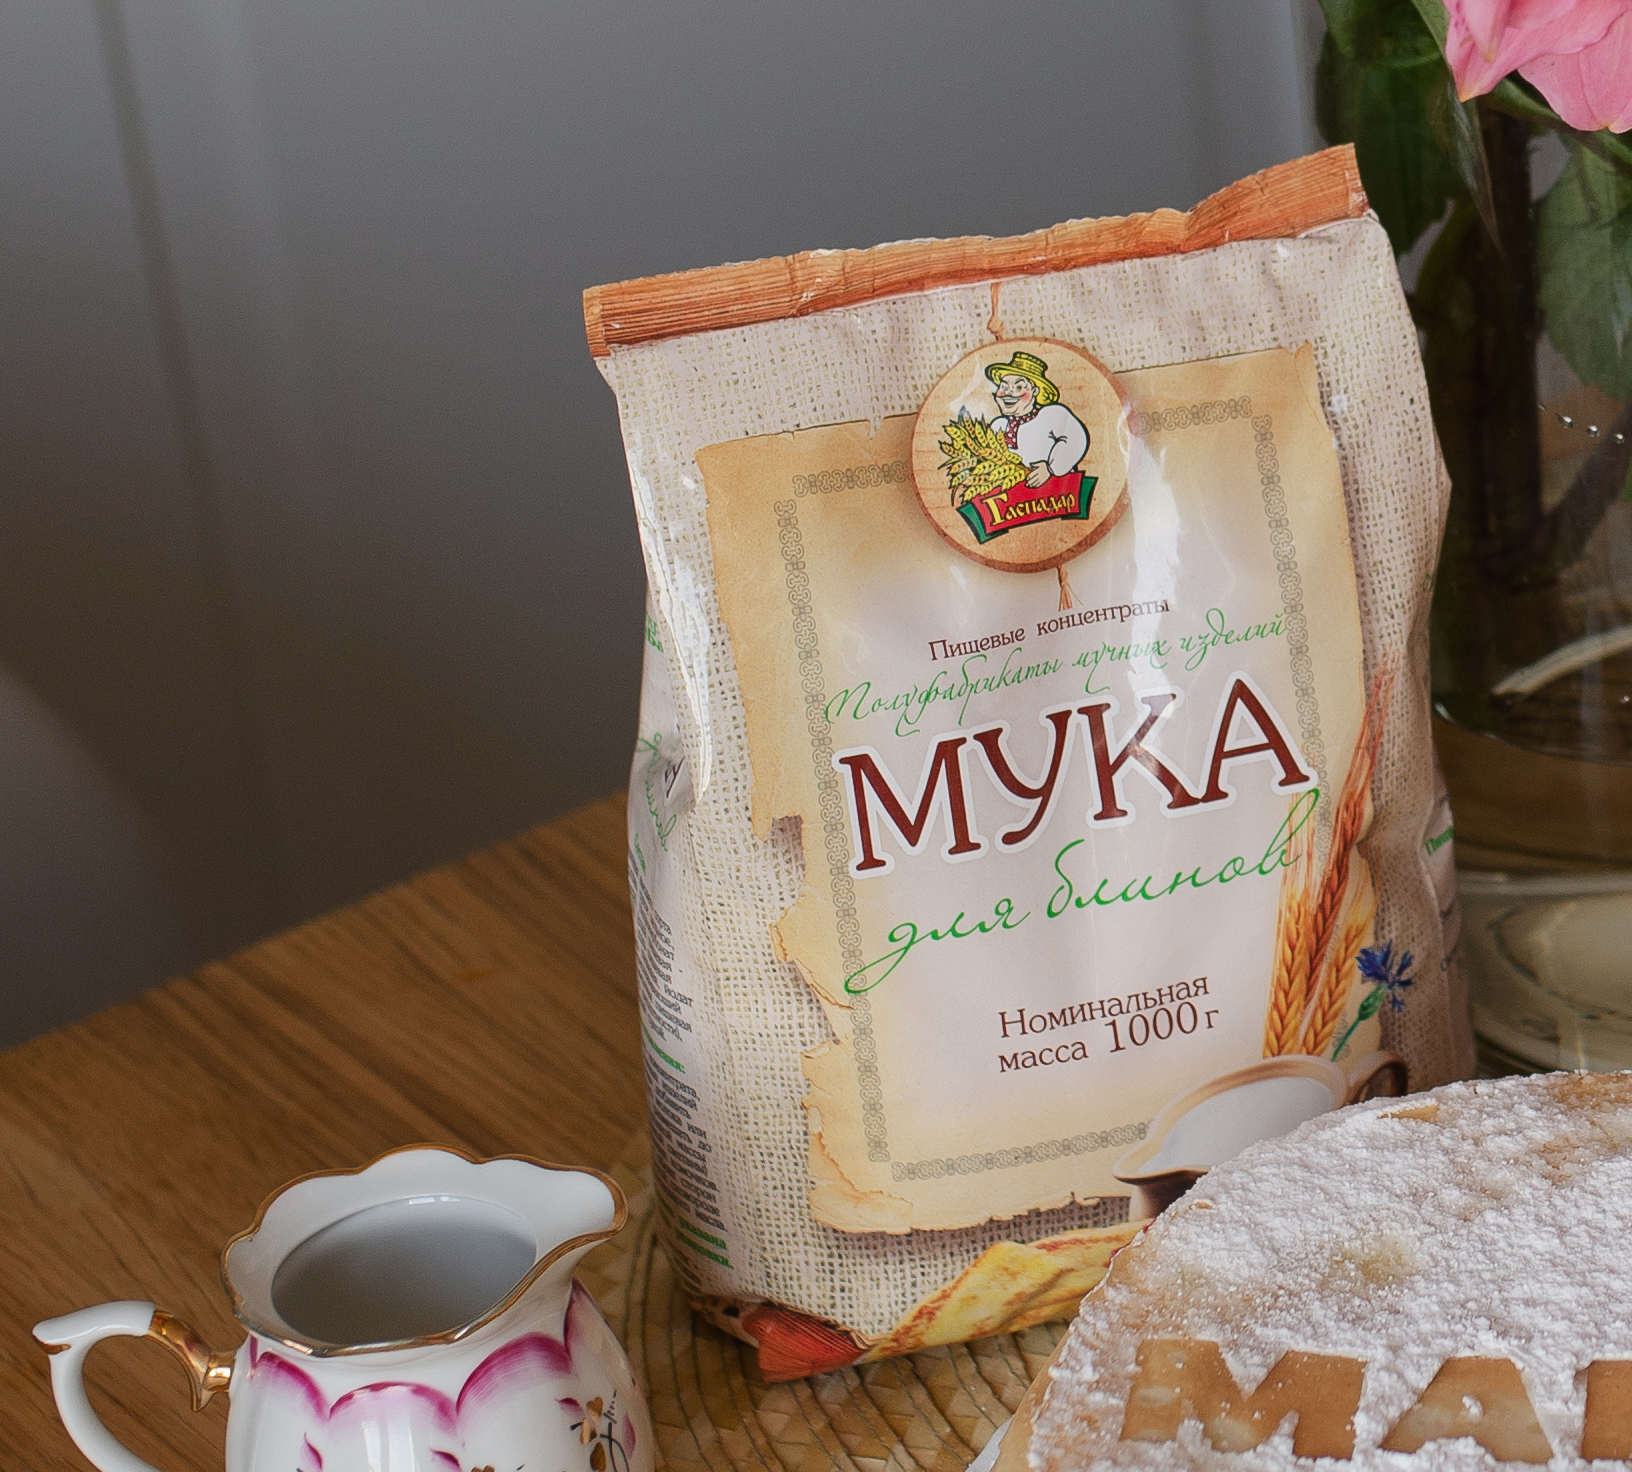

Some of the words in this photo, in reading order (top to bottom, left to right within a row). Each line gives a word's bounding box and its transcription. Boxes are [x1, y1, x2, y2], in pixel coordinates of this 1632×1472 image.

[982, 491, 1077, 527] Гаспадар
[928, 627, 1026, 662] Пищевые
[1036, 598, 1170, 637] концентраты
[824, 647, 1063, 737] Полуфабрикаты
[1071, 635, 1173, 694] мучных
[1178, 607, 1289, 671] изделий
[838, 678, 1310, 871] МУКА
[844, 897, 1031, 996] для
[1046, 787, 1320, 919] блинов
[998, 975, 1211, 1039] Номинальная
[998, 1037, 1090, 1073] масса
[1103, 1000, 1199, 1055] 1000
[1203, 1005, 1221, 1031] г
